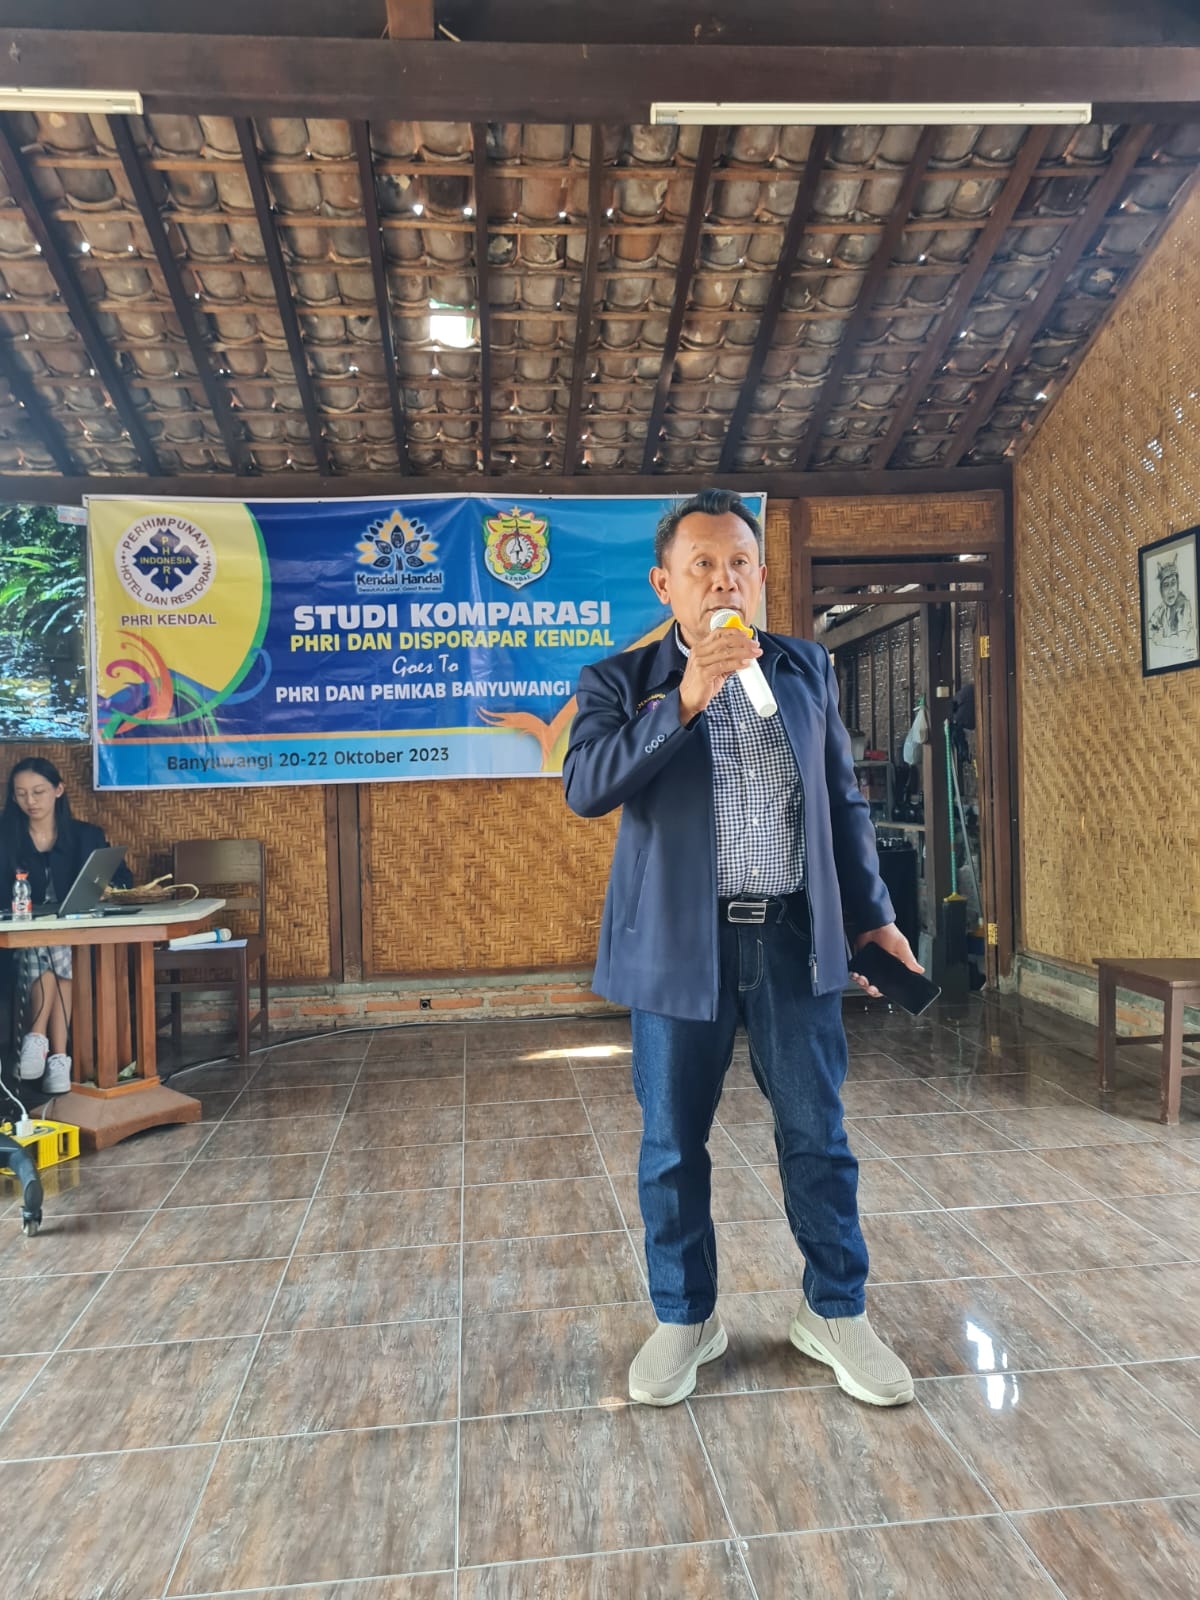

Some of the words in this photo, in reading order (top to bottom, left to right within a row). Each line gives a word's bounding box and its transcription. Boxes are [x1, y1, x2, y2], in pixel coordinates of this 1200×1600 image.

[123, 517, 208, 549] PERHIMPUNAN
[140, 556, 192, 565] INDONESIA
[121, 564, 142, 598] HOTEL
[144, 593, 168, 606] DAN
[171, 562, 212, 605] RESTORAN
[357, 573, 398, 585] Kendal
[401, 572, 442, 584] Handal
[121, 615, 153, 626] PHRI
[157, 614, 217, 625] KENDAL
[294, 603, 398, 630] STUDI
[411, 601, 611, 627] KOMPARASI
[290, 634, 340, 652] PHRI
[347, 633, 392, 650] DAN
[400, 630, 528, 649] DISPORAPAR
[534, 629, 615, 647] KENDAL
[392, 656, 434, 677] Goes
[439, 654, 459, 673] To
[276, 685, 320, 703] PHRI
[325, 684, 365, 701] DAN
[371, 682, 447, 700] PEMKAB
[451, 681, 571, 698] BANYUWANGI
[167, 752, 273, 772] Banyuwangi
[279, 751, 328, 767] 20-22
[334, 749, 404, 765] Oktober
[409, 747, 449, 763] 2023
